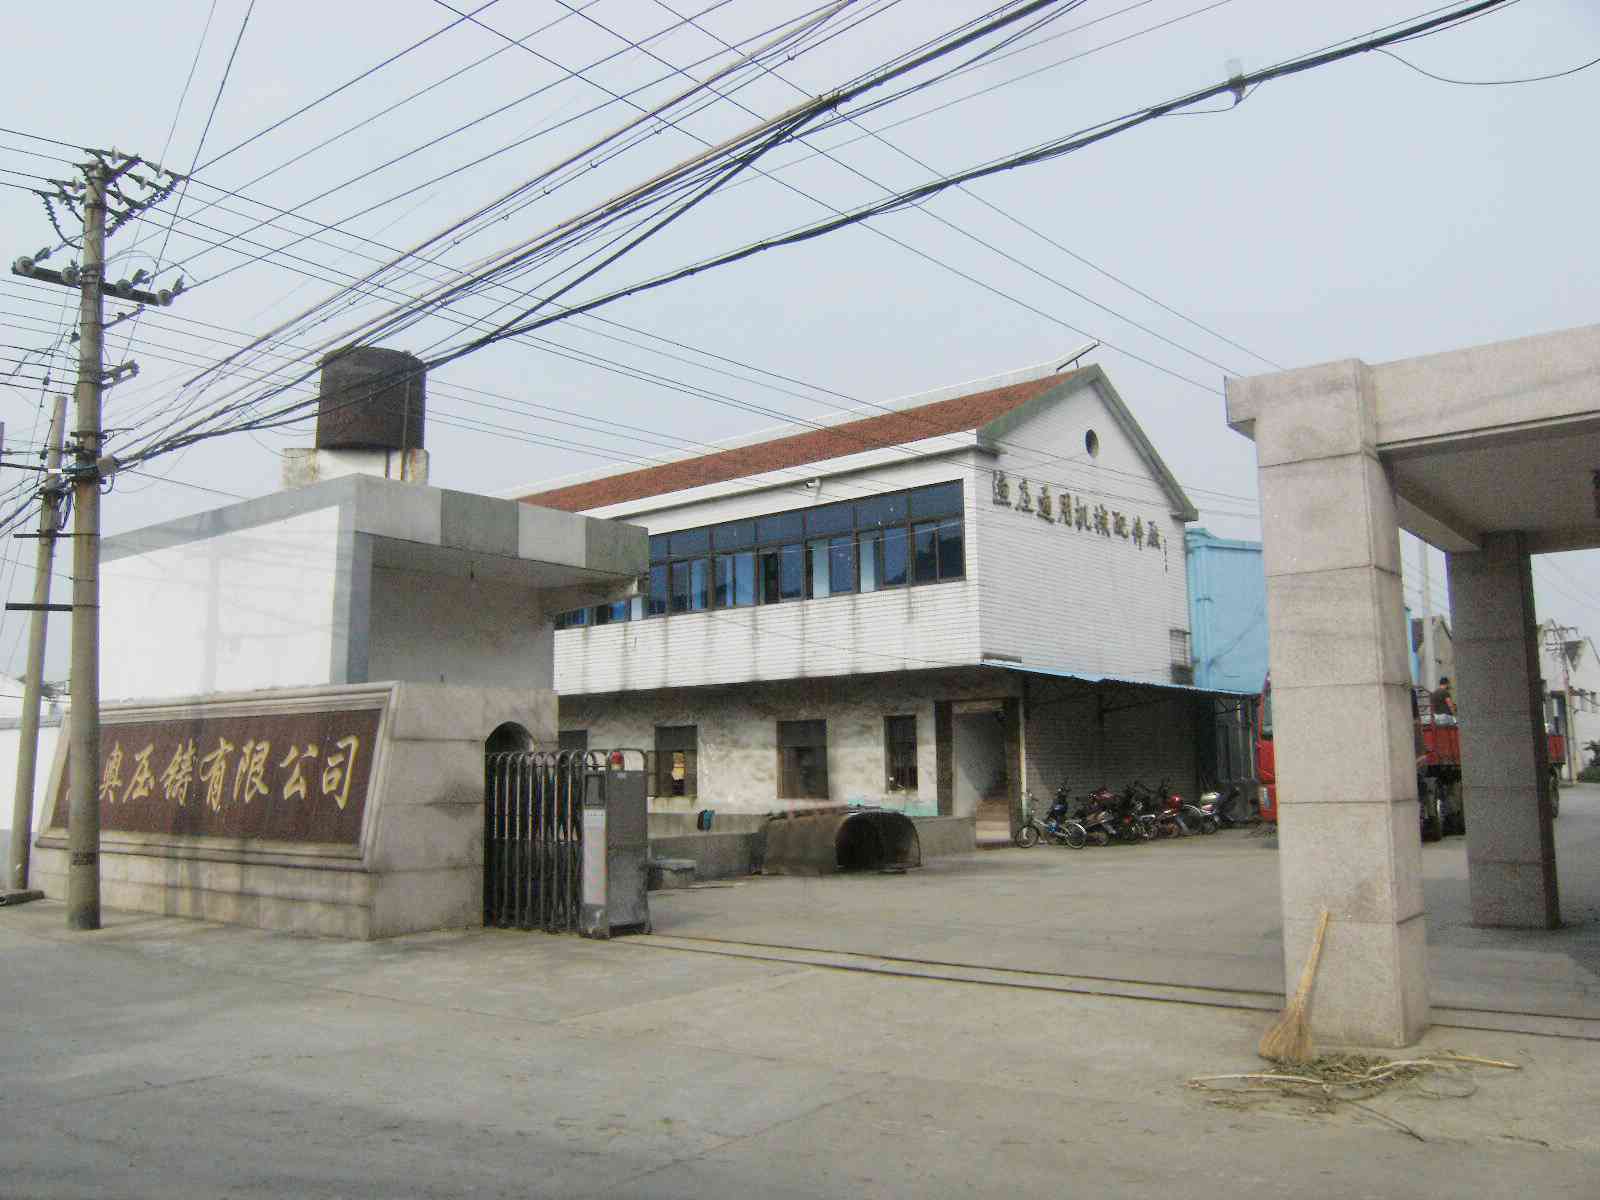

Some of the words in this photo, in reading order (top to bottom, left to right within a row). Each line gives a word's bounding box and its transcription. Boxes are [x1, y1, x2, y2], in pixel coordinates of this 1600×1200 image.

[66, 736, 359, 812] 奥压铸有限公司
